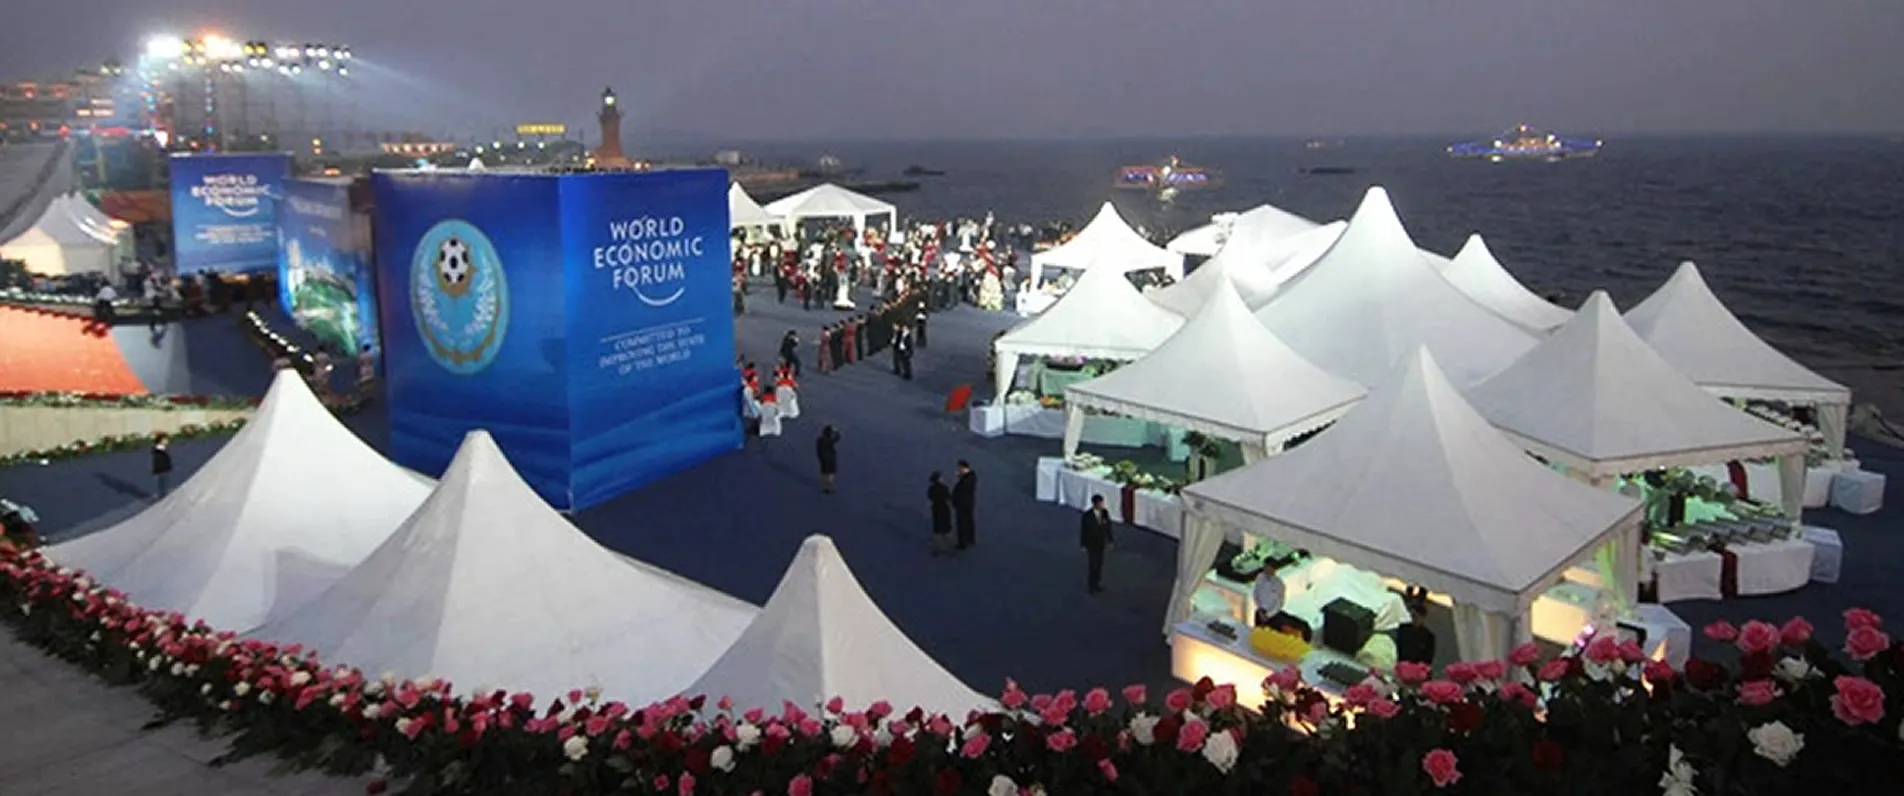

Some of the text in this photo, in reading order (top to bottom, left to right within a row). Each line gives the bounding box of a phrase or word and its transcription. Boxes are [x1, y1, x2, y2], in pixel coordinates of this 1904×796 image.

[203, 174, 258, 185] WORLD
[609, 216, 684, 240] WORLD
[593, 236, 703, 269] ECONOMIC
[613, 262, 685, 290] FORUM
